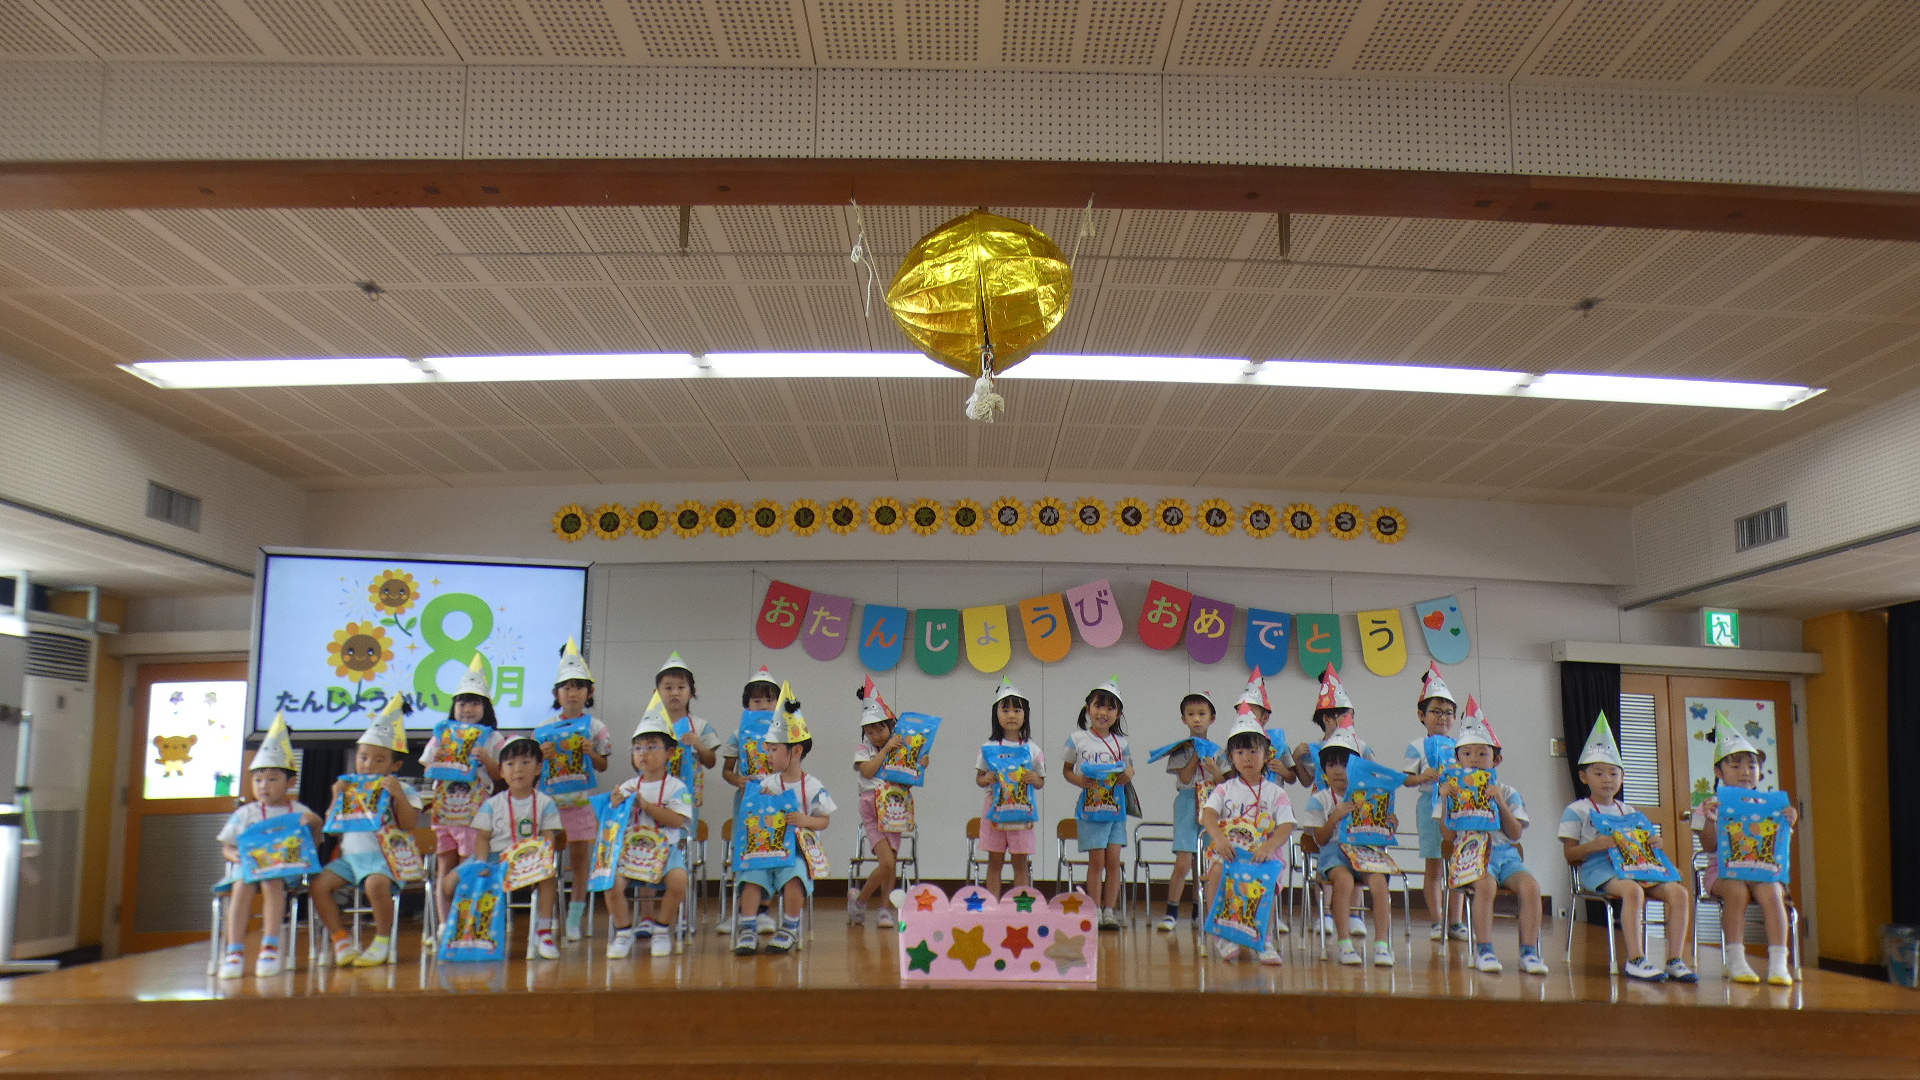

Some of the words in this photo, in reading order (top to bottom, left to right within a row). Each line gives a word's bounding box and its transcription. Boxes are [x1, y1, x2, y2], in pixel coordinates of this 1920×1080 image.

[765, 589, 1109, 652] おたんじょうび
[1147, 596, 1394, 653] おめでとう
